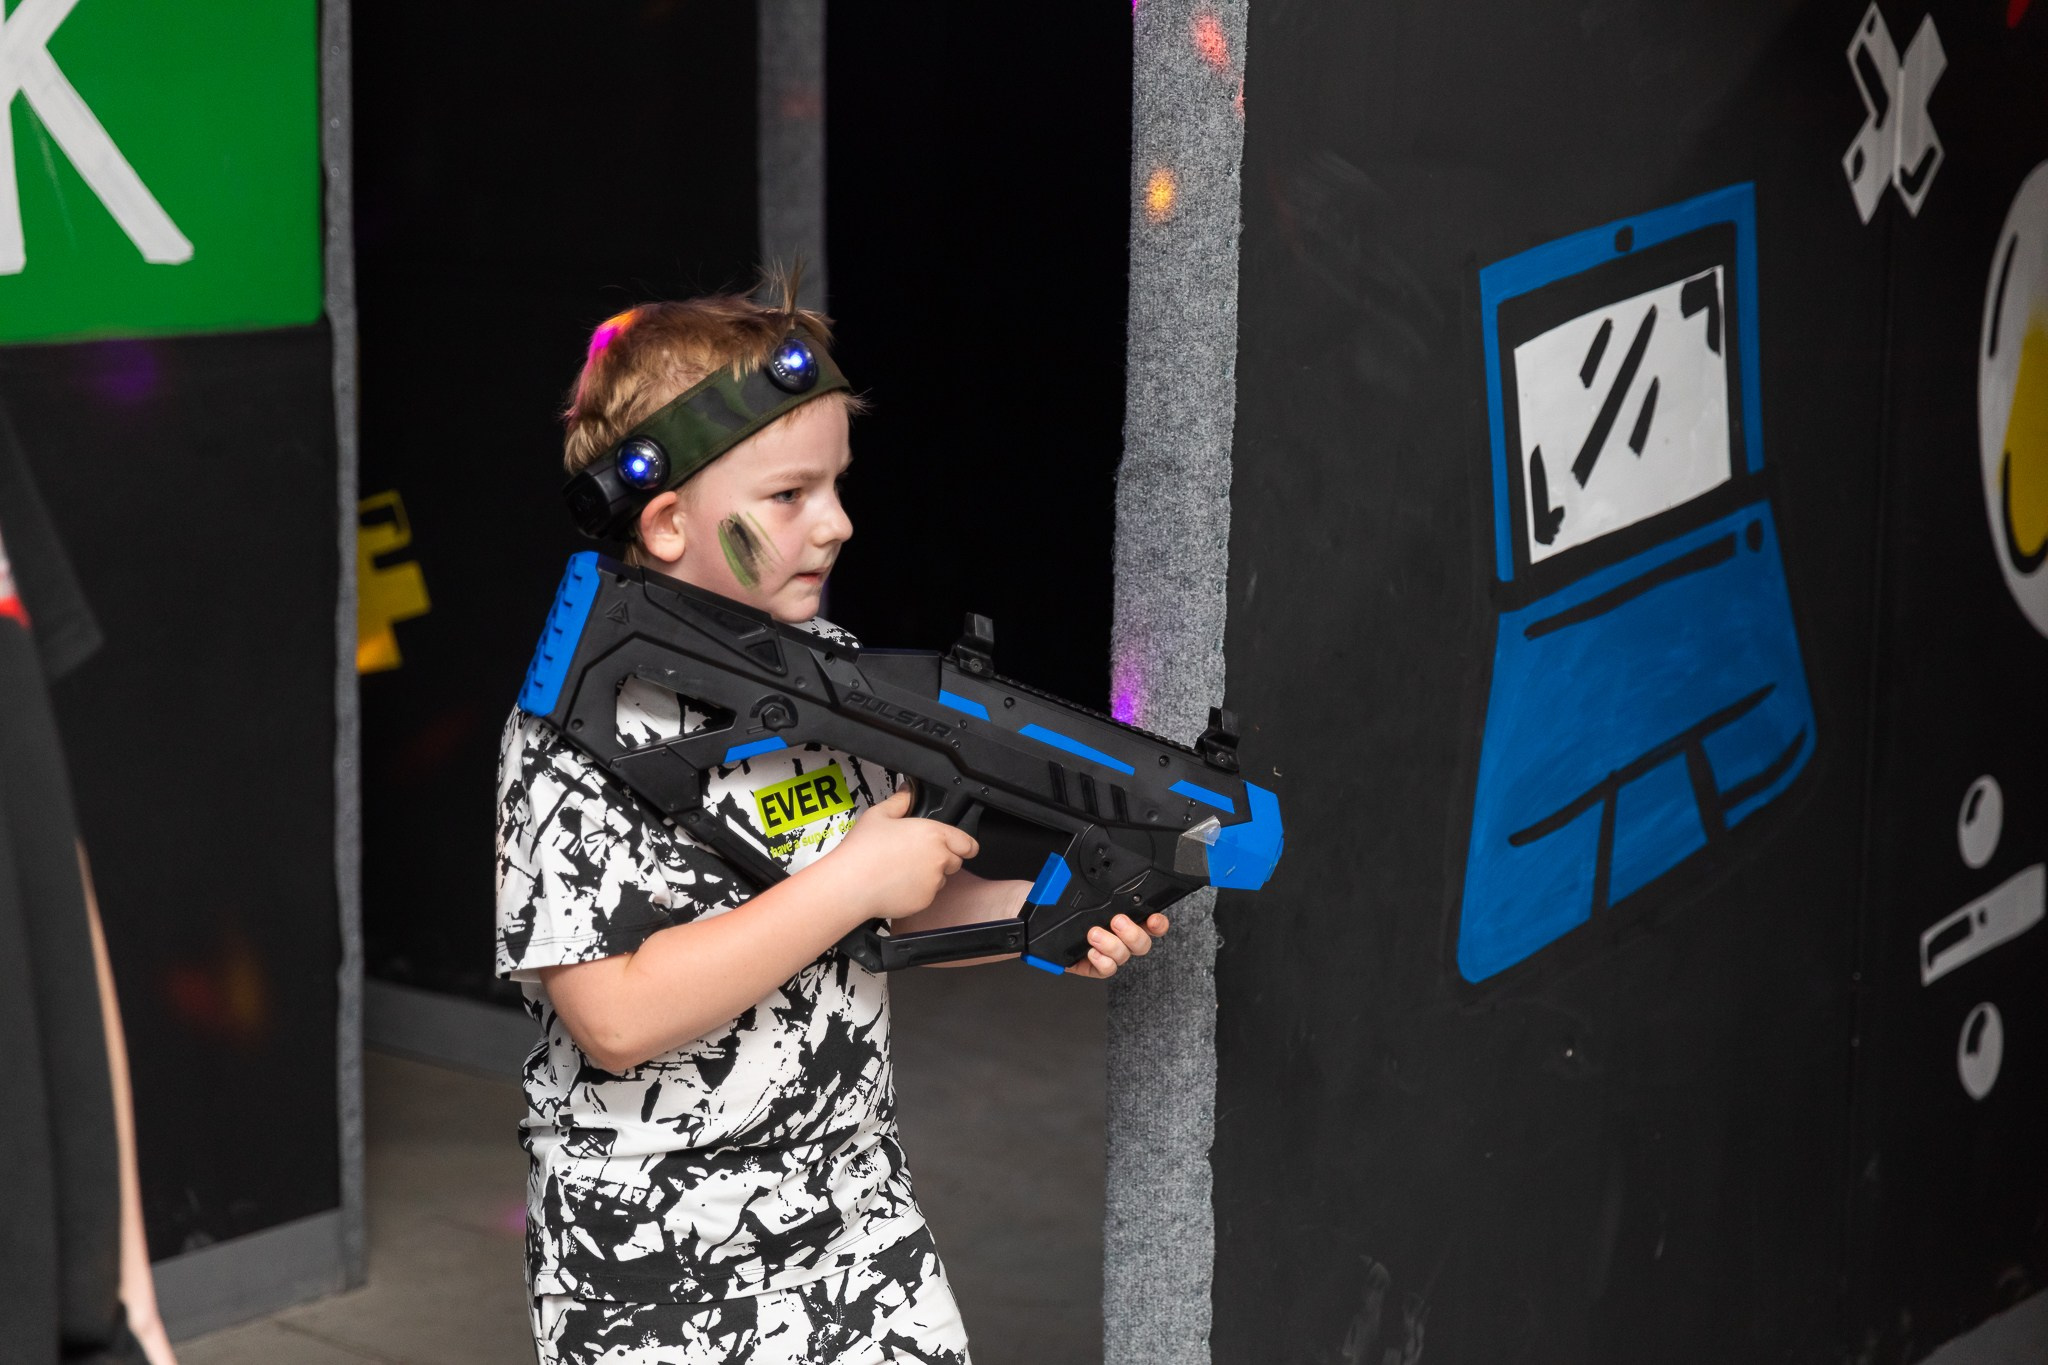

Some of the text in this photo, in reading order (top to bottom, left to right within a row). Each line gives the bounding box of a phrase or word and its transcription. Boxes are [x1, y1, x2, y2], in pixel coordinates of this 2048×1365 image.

[844, 691, 952, 737] PULSAR
[761, 775, 843, 828] EVER
[770, 842, 792, 858] have
[793, 839, 801, 849] a
[802, 827, 835, 846] super
